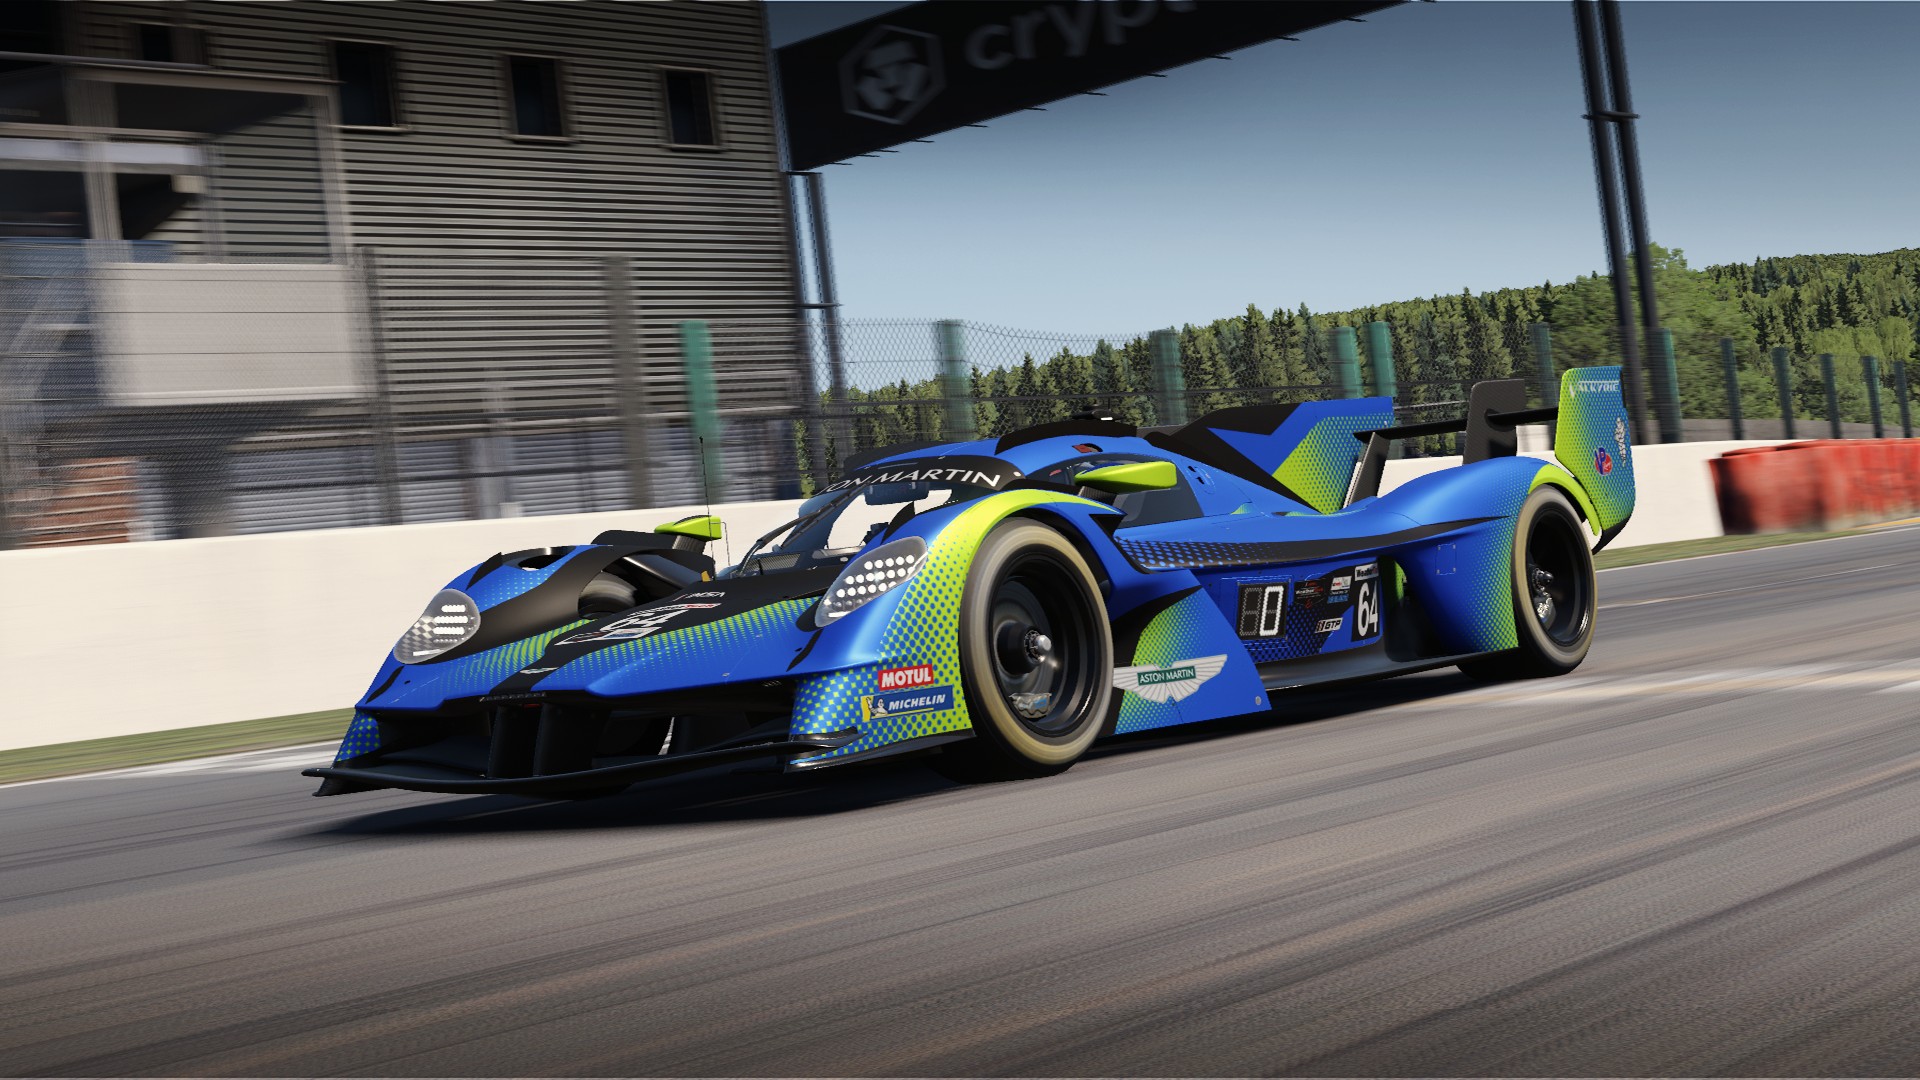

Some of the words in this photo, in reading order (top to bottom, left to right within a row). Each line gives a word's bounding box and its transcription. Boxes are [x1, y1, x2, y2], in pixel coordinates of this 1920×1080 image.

[964, 0, 1197, 70] cryp
[871, 468, 1000, 487] MARTIN
[1357, 580, 1378, 637] 64
[1324, 619, 1342, 630] GTP
[881, 667, 932, 688] MOTUL
[1139, 672, 1165, 684] ASTON
[1166, 668, 1195, 680] MARTIN
[888, 694, 946, 711] MICHELIN
